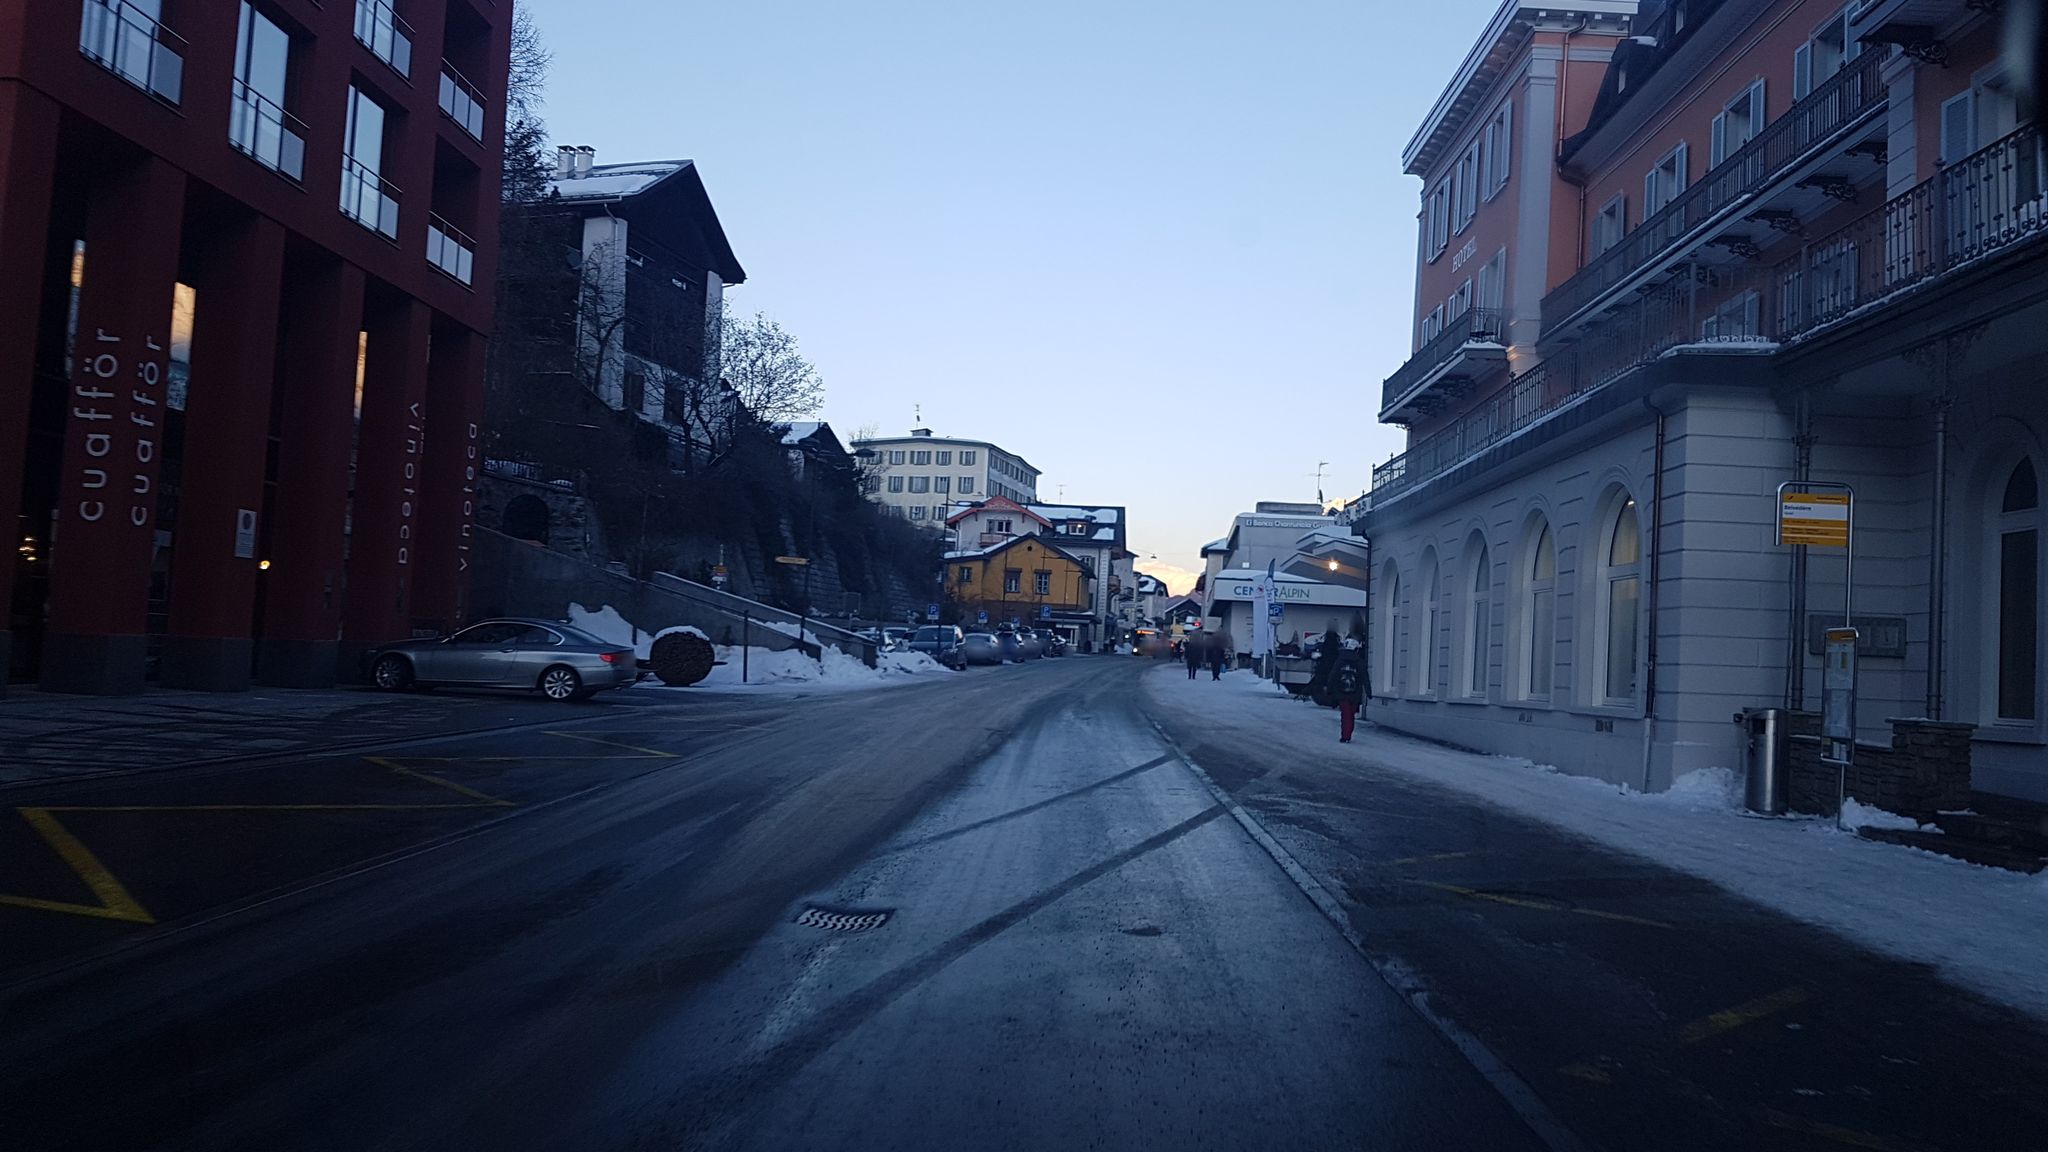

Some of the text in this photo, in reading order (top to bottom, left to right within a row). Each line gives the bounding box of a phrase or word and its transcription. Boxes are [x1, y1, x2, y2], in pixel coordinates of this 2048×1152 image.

[1452, 236, 1477, 273] HOTEL
[74, 327, 121, 521] cuafför
[131, 335, 163, 527] cuafför
[397, 401, 420, 565] vinoteca
[458, 422, 478, 572] vinoteca
